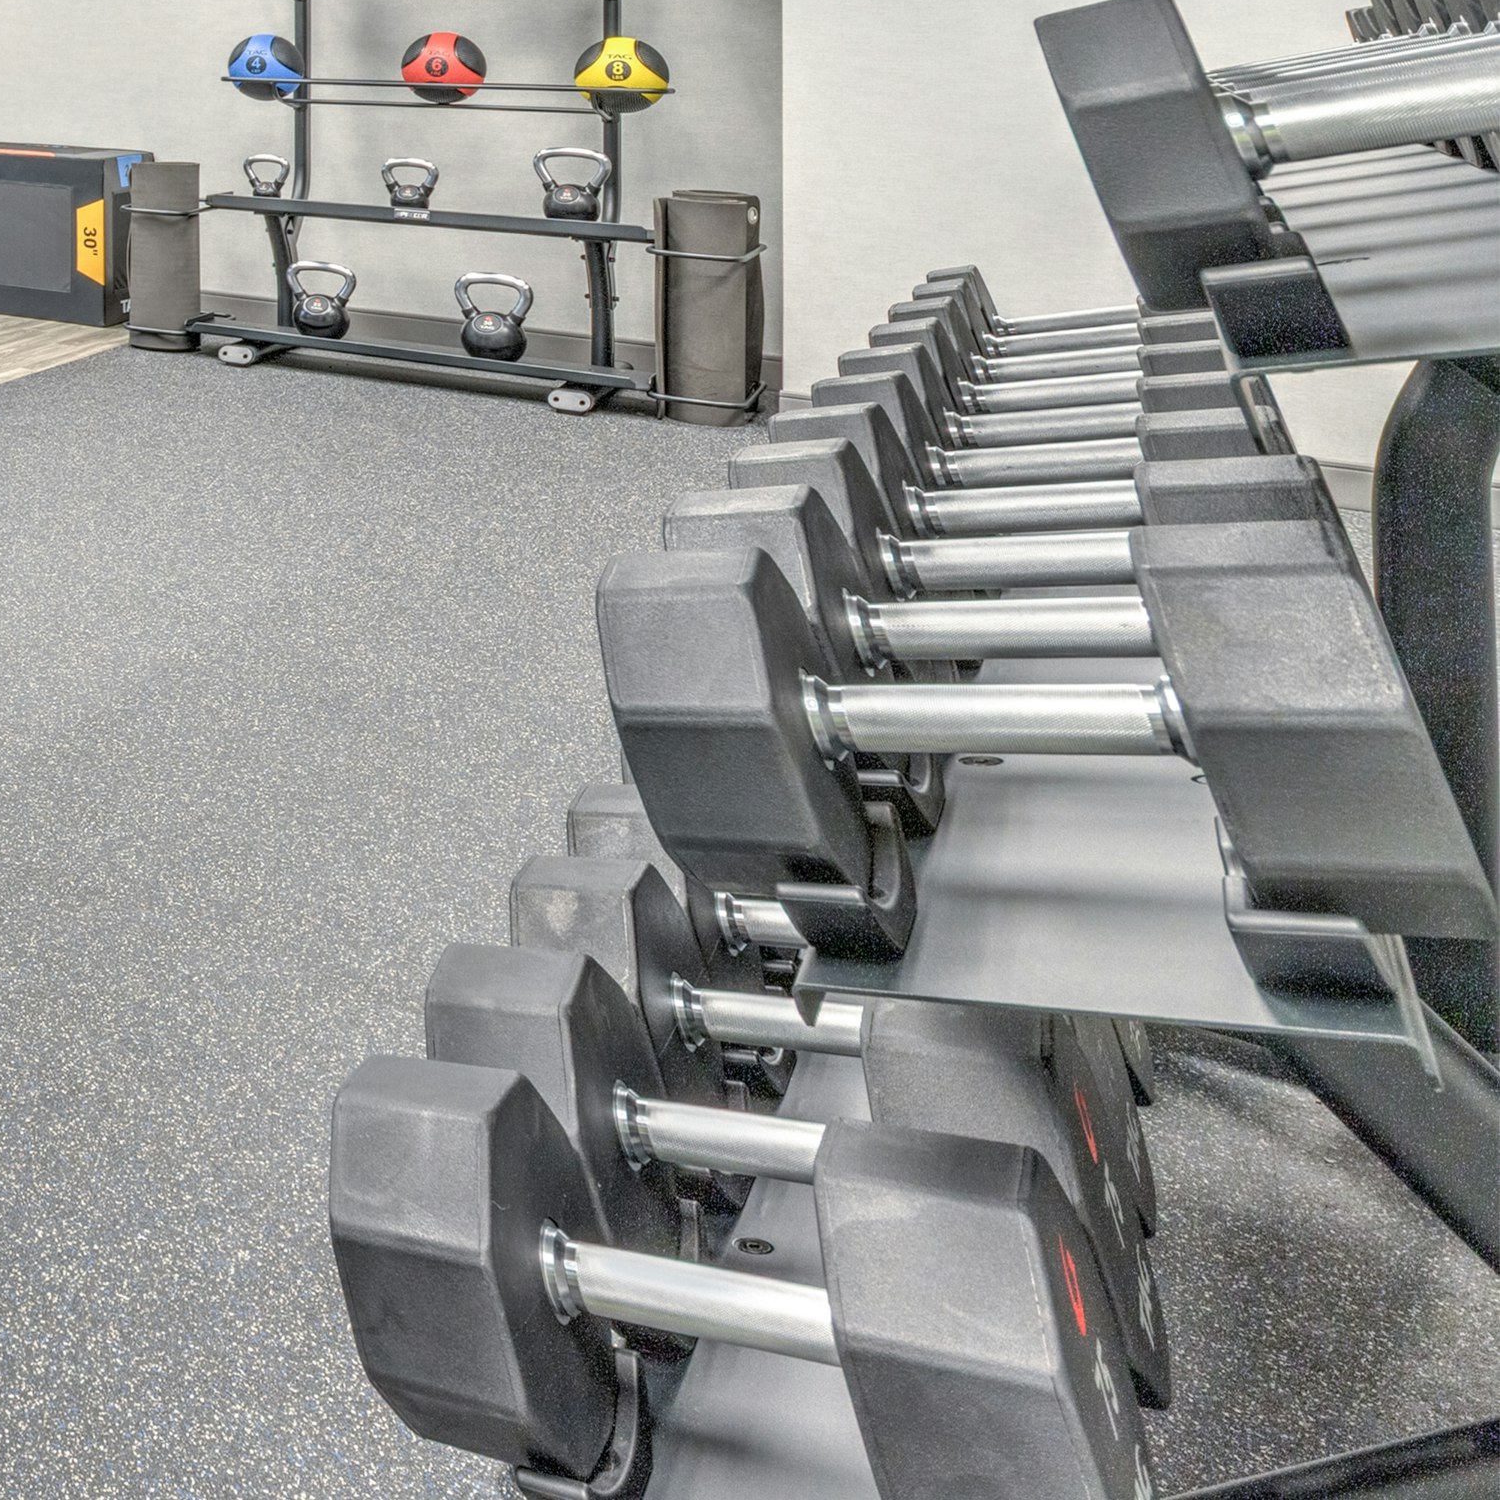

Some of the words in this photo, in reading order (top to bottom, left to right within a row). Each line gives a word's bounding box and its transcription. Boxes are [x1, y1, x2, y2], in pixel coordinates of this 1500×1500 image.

[251, 56, 262, 69] 4
[431, 58, 443, 71] 6
[611, 60, 624, 75] 8
[83, 226, 98, 256] 30"
